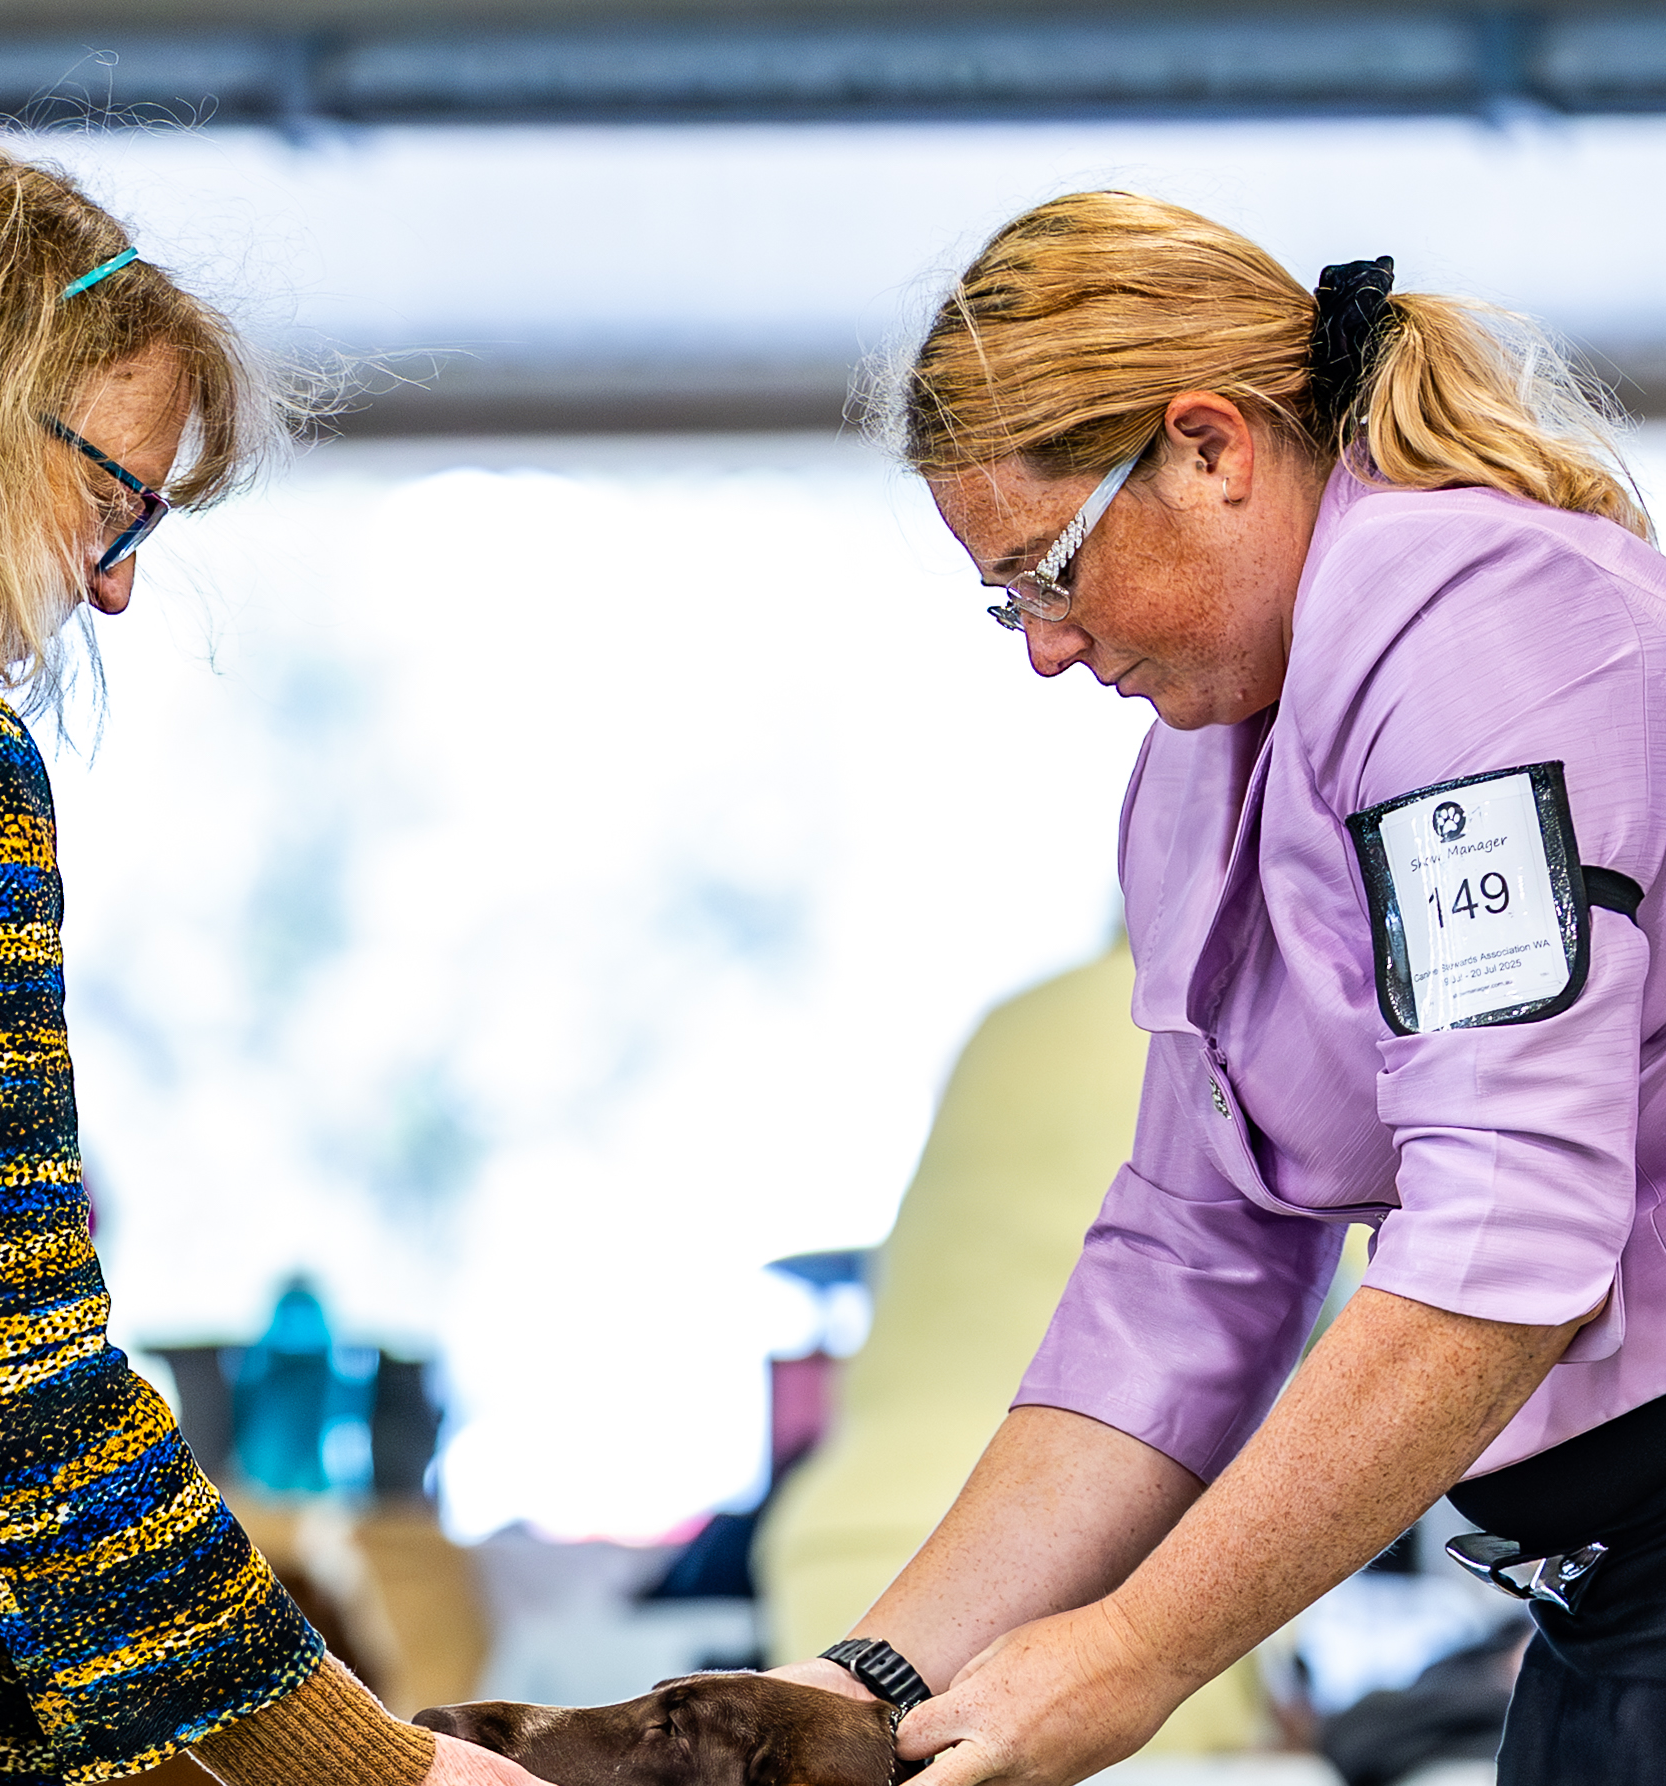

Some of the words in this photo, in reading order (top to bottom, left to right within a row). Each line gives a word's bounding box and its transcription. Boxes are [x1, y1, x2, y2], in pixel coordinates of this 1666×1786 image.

[1447, 836, 1508, 859] Manager
[1428, 872, 1510, 928] 149
[1479, 943, 1531, 961] Association
[1532, 939, 1551, 950] WA
[1471, 968, 1482, 979] 20
[1484, 963, 1497, 975] Jul
[1498, 958, 1522, 971] 2025
